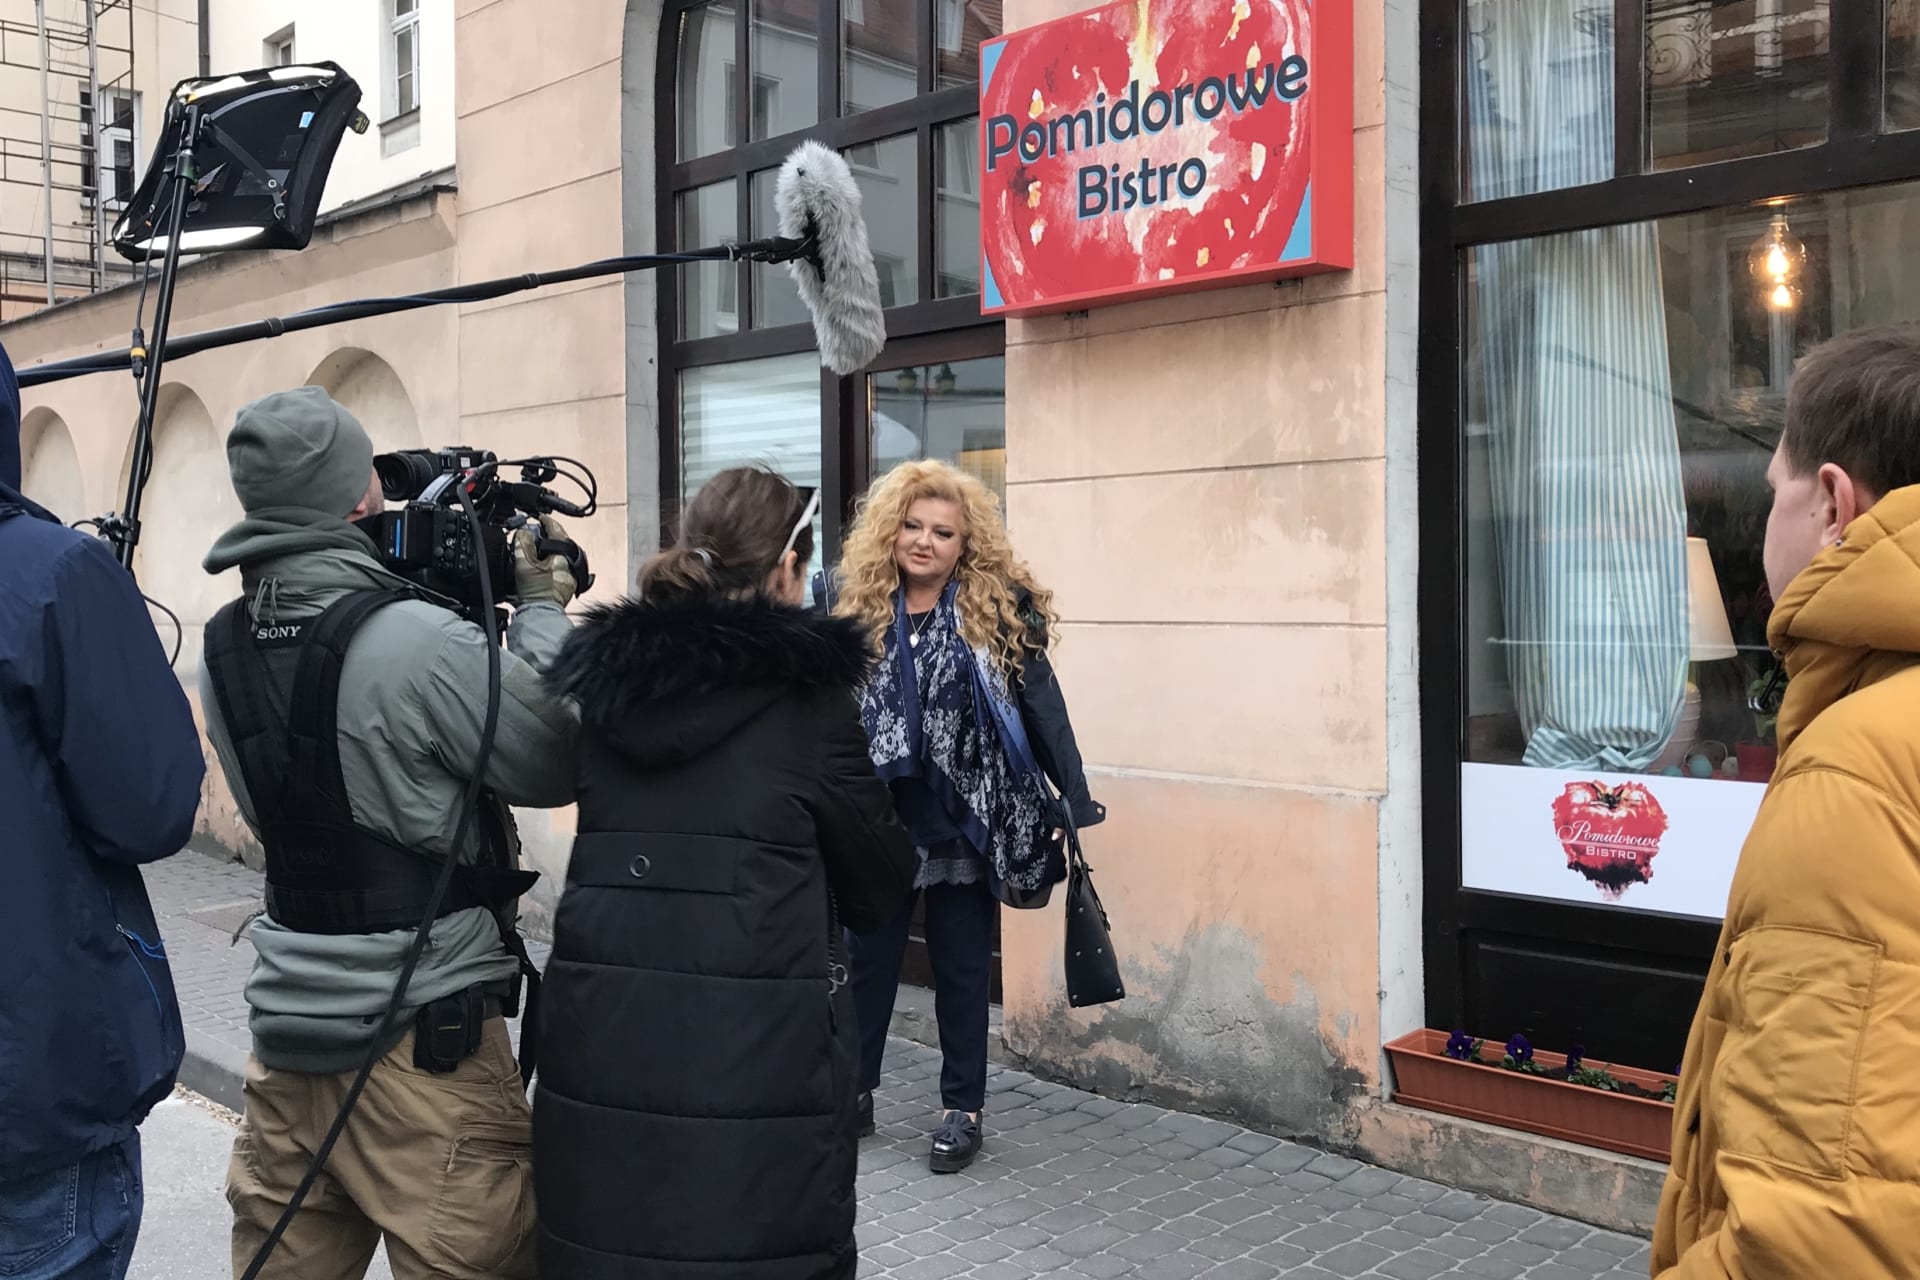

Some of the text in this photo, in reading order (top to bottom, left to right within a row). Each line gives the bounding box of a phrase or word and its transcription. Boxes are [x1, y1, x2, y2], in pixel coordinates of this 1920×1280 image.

[985, 53, 1308, 172] Pomidorowe
[1078, 156, 1207, 220] Bistro
[256, 625, 301, 640] SONY
[1556, 820, 1660, 848] Pomidorowe
[1586, 846, 1637, 860] BISTRO
